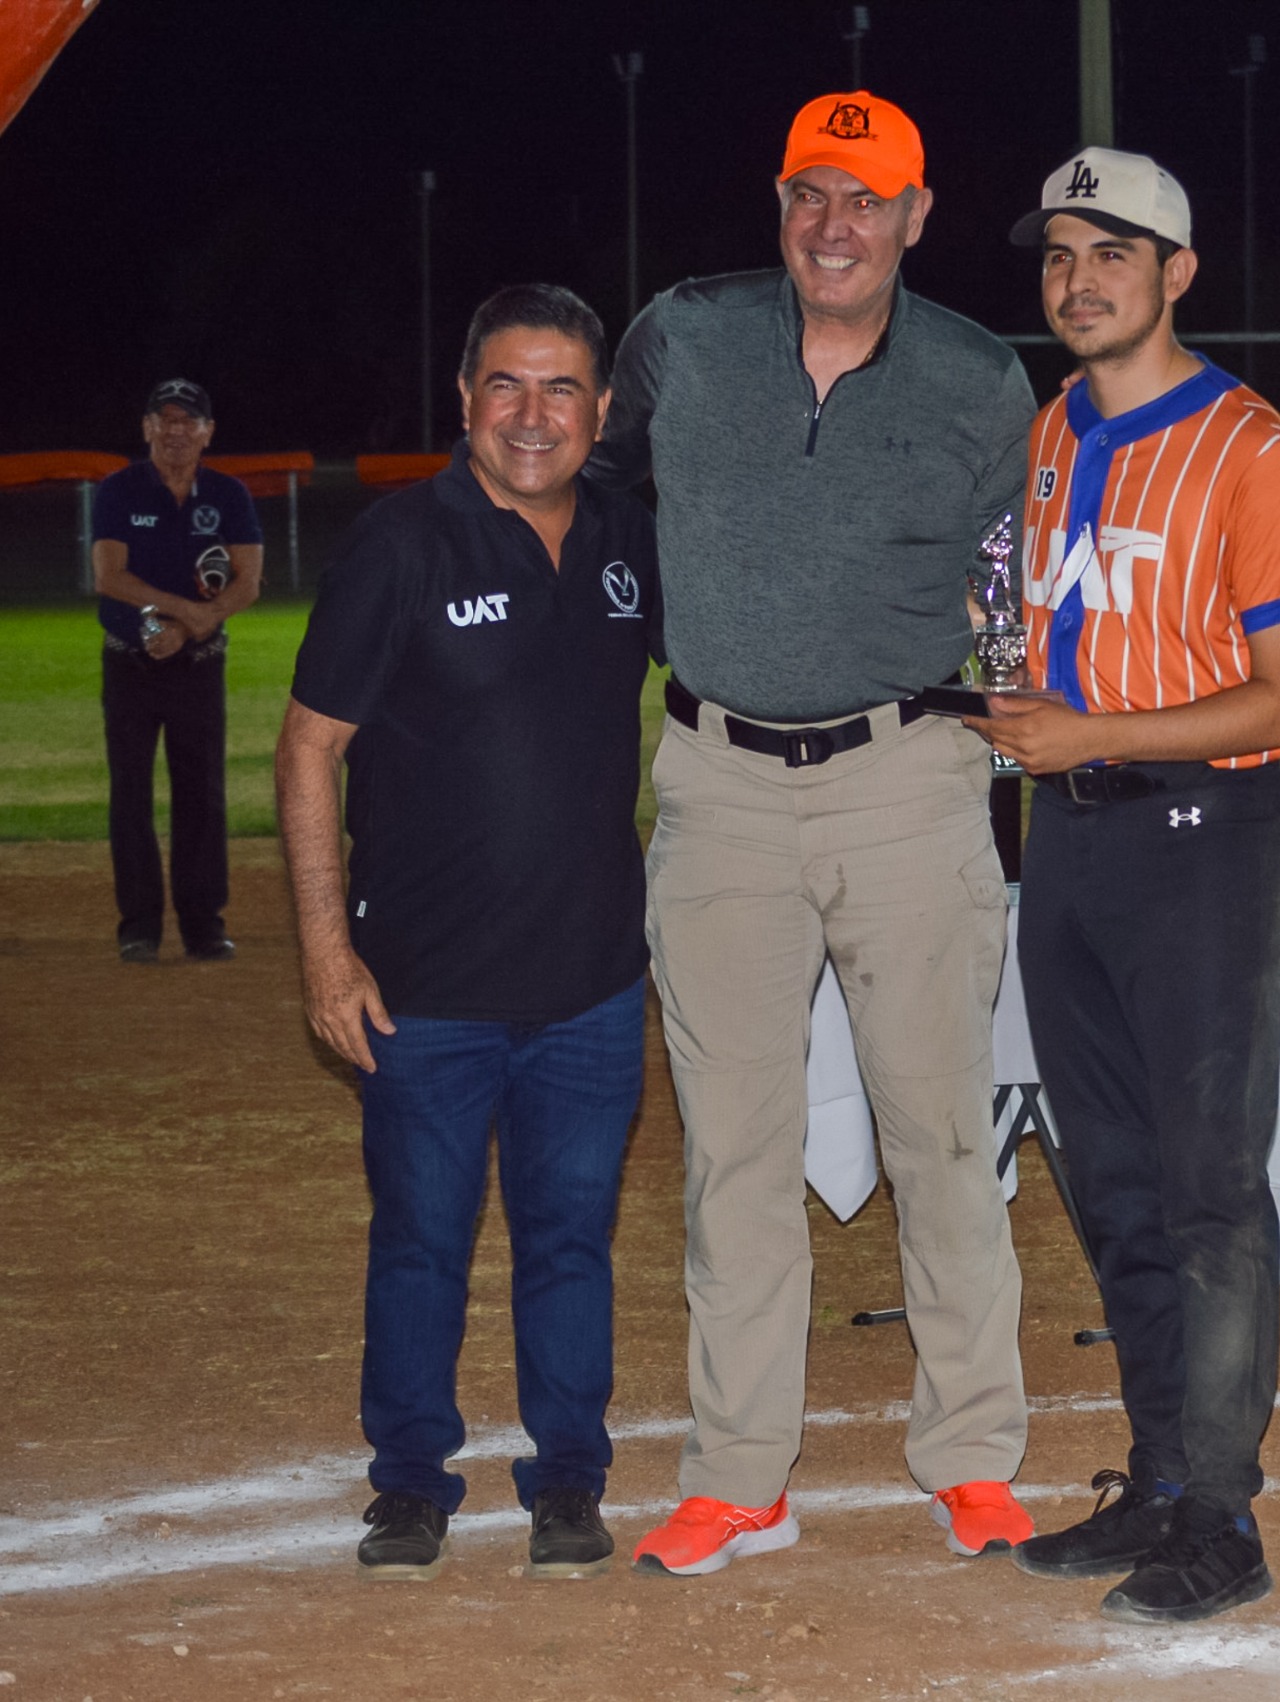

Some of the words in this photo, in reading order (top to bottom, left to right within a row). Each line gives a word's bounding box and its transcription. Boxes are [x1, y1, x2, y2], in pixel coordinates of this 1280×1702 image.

[1066, 159, 1099, 199] LA
[1036, 468, 1056, 498] 19
[130, 514, 158, 527] UAT
[1022, 521, 1163, 614] UAT
[447, 593, 510, 627] UAT
